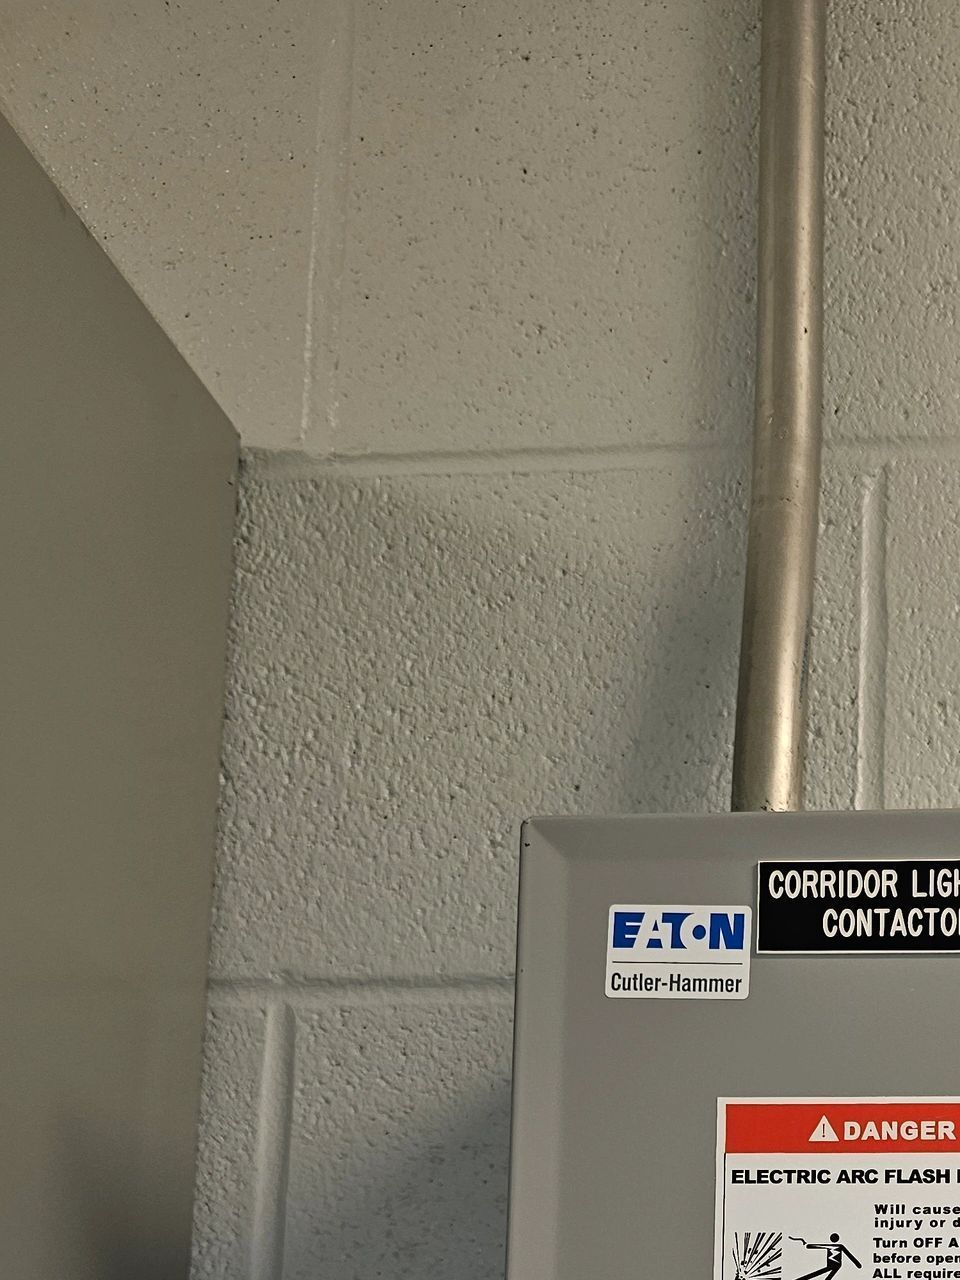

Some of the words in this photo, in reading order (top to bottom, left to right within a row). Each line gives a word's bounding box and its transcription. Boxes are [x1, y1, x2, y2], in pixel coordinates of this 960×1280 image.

[768, 870, 898, 899] CORRIDOR
[612, 912, 745, 950] EATON
[611, 972, 742, 993] Cutler-Hammer
[844, 1121, 956, 1140] DANGER
[732, 1169, 831, 1184] ELECTRIC
[837, 1169, 878, 1184] ARC
[885, 1169, 950, 1183] FLASH
[875, 1204, 906, 1215] Will
[913, 1206, 960, 1215] cause
[874, 1218, 923, 1230] injury
[930, 1220, 946, 1228] or
[873, 1238, 908, 1248] Turn
[913, 1238, 943, 1248] OFF
[873, 1253, 921, 1263] before
[873, 1268, 902, 1279] ALL
